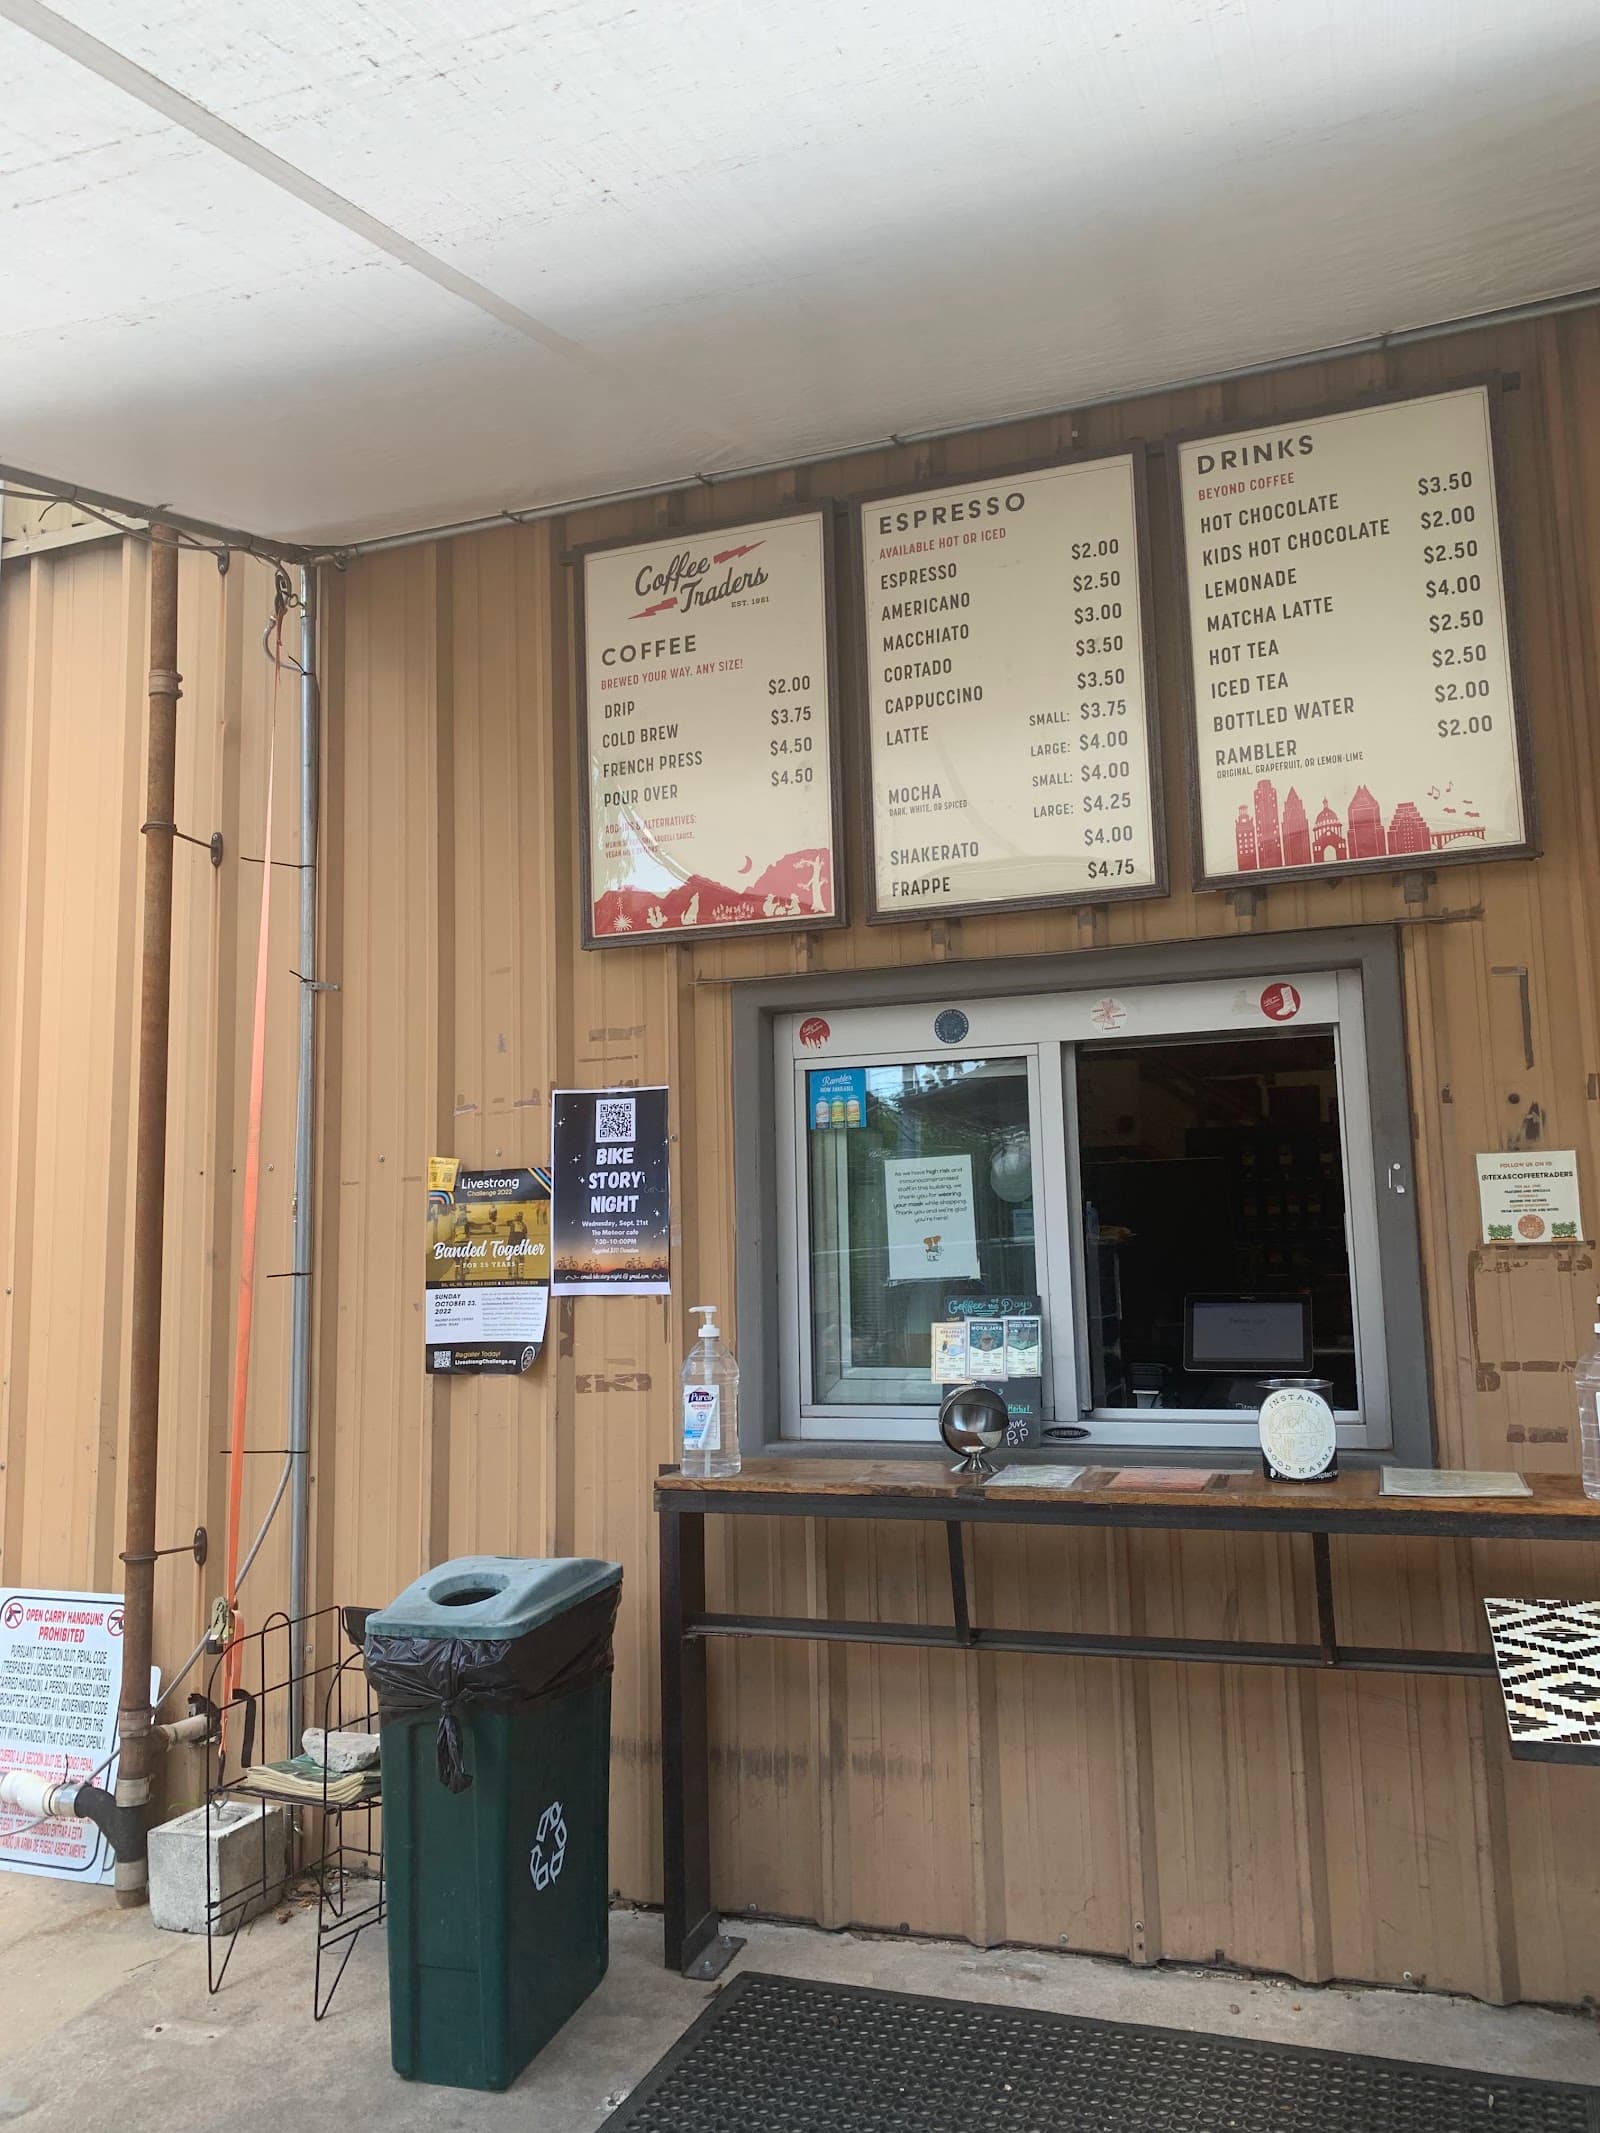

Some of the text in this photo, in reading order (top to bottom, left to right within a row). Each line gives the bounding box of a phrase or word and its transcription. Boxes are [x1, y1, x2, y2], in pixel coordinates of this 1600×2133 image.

[1197, 435, 1313, 475] DRINKS
[1198, 472, 1294, 501] BEYOND COFFEE
[1418, 471, 1472, 496] $3.50
[880, 492, 1025, 535] ESPRESSO
[1201, 493, 1339, 534] HOT CHOCOLATE
[1421, 505, 1475, 530] $2.00
[880, 528, 1006, 560] AVAILABLE HOT OR ICED
[1072, 539, 1118, 560] $2.00
[1203, 518, 1390, 566] KIDS HOT CHOCOLATE
[1424, 540, 1477, 564] $2.50
[635, 551, 711, 596] Coffee
[881, 563, 957, 590] ESPRESSO
[1073, 571, 1120, 592] $2.50
[1205, 568, 1297, 599] LEMONADE
[680, 566, 769, 613] Traders
[1426, 574, 1480, 598] $4.00
[731, 600, 749, 608] EST.
[882, 592, 970, 621] AMERICANO
[1074, 603, 1122, 624] $3.00
[1207, 596, 1333, 632] MATCHA LATTE
[1429, 609, 1483, 633] $2.50
[602, 634, 696, 666] COFFEE
[883, 624, 969, 652] MACCHIATO
[1076, 635, 1123, 657] $3.50
[1209, 639, 1279, 666] HOT TEA
[1432, 644, 1486, 668] $2.50
[601, 674, 639, 690] BREWED
[642, 670, 667, 683] YOUR
[696, 662, 715, 675] ANY
[718, 658, 743, 671] SIZE!
[884, 658, 952, 683] CORTADO
[1077, 668, 1124, 690] $3.50
[769, 675, 810, 695] $2.00
[1211, 672, 1288, 699] ICED TEA
[1435, 680, 1489, 703] $2.00
[605, 701, 635, 719] DRIP
[885, 685, 983, 714] CAPPUCCINO
[771, 706, 811, 726] $3.75
[1029, 699, 1126, 726] SMALL: $3.75
[1214, 697, 1354, 732] BOTTLED WATER
[603, 723, 678, 748] COLD BREW
[887, 725, 928, 746] LATTE
[1438, 715, 1492, 738] $2.00
[770, 737, 812, 756] $4.50
[1031, 730, 1128, 757] LARGE: $4.00
[1216, 740, 1296, 766] RAMBLER
[603, 751, 702, 778] FRENCH PRESS
[1032, 761, 1129, 787] SMALL: $4.00
[1305, 758, 1315, 767] OR
[771, 767, 813, 787] $4.50
[604, 784, 678, 807] POUR OVER
[889, 784, 942, 805] MOCHA
[933, 803, 942, 811] OR
[944, 799, 967, 810] SPICED
[1034, 792, 1131, 818] LARGE: $4.25
[1084, 825, 1132, 846] $4.00
[891, 841, 979, 866] SHAKERATO
[1088, 858, 1134, 879] $4.75
[892, 877, 950, 897] FRAPPE
[596, 1147, 634, 1165] BIKE
[461, 1178, 520, 1190] Livestrong
[588, 1171, 642, 1189] STORY
[1481, 1171, 1573, 1181] @TEXASCOFFEETRADERS
[590, 1195, 639, 1214] NIGHT
[619, 1220, 634, 1228] Sept.
[433, 1239, 546, 1260] Banded Together
[1269, 1394, 1321, 1408] INSTANT
[1268, 1446, 1333, 1474] GOOD KARMA
[26, 1608, 104, 1626] OPEN CARRY HANDGUNS
[39, 1626, 85, 1643] PROHIBITED
